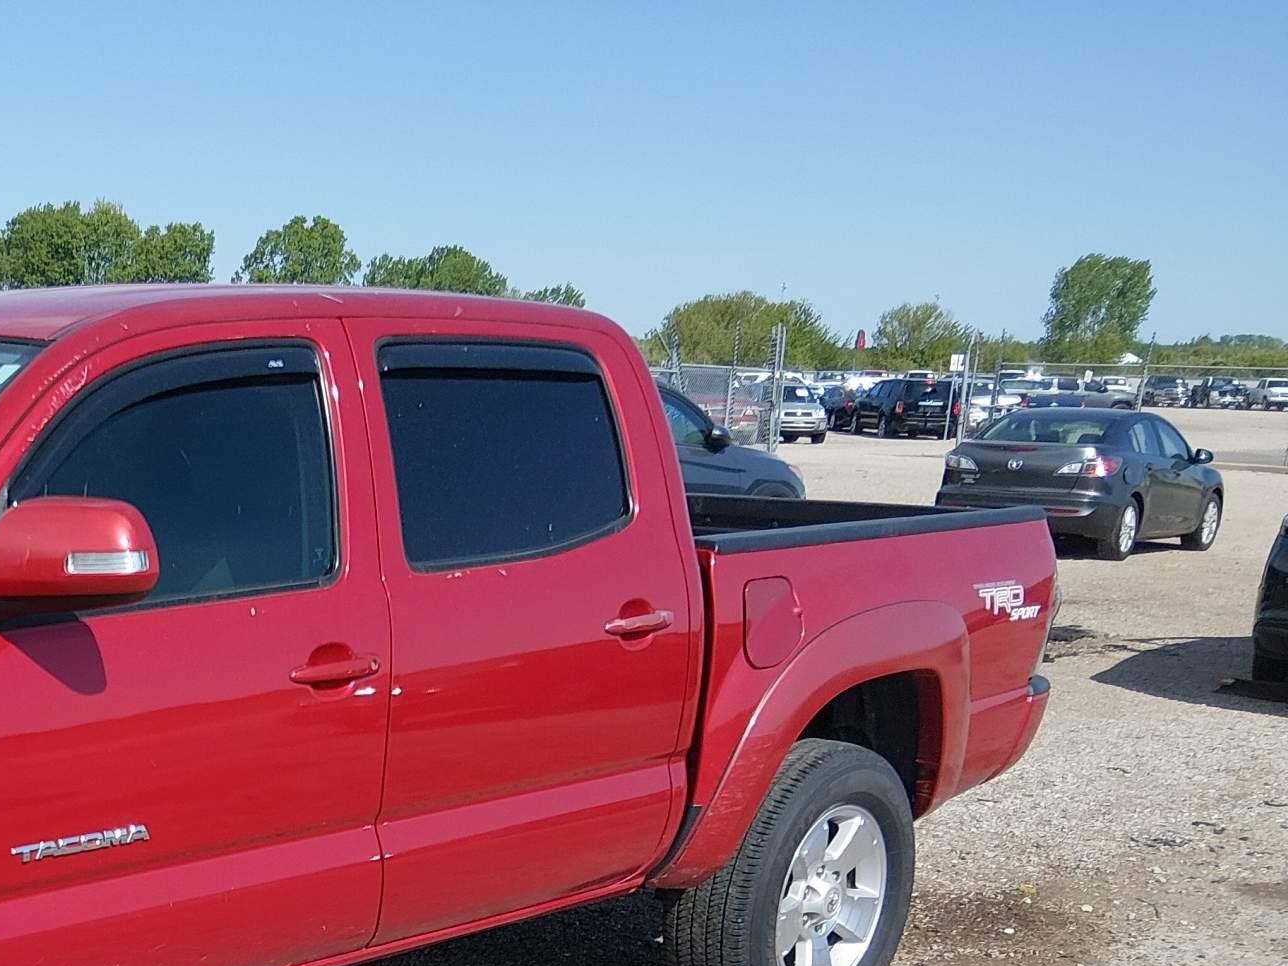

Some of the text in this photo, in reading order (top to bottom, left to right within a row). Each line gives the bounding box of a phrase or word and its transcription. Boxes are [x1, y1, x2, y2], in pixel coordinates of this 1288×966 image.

[978, 584, 1024, 616] TRD
[1009, 605, 1041, 621] SPORT
[10, 824, 151, 864] TACOMA
